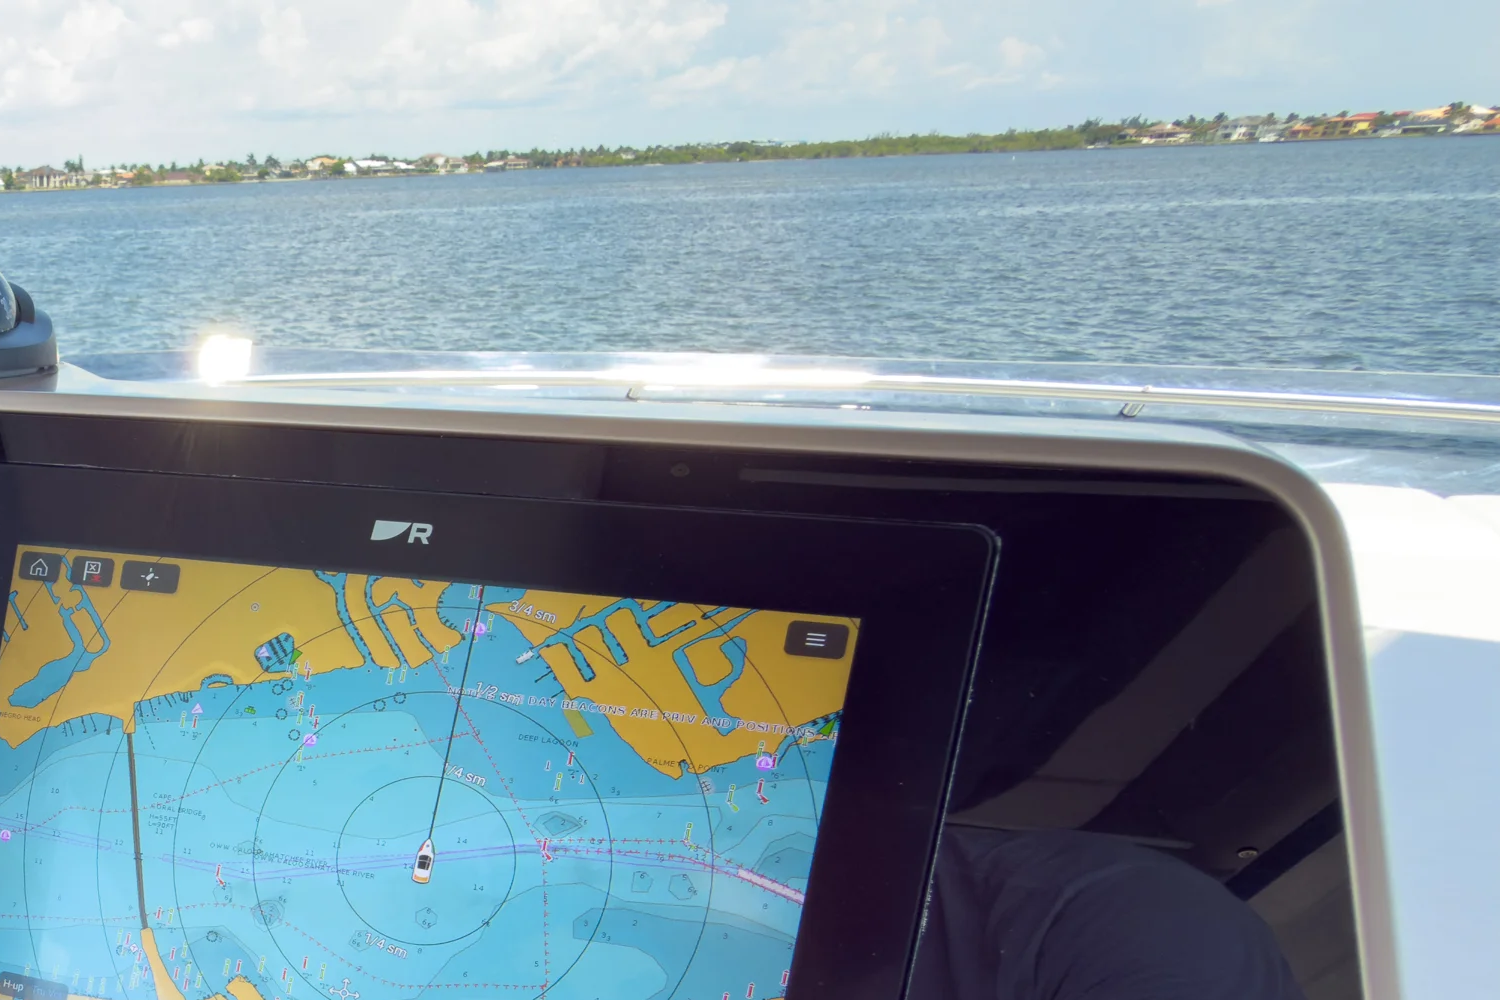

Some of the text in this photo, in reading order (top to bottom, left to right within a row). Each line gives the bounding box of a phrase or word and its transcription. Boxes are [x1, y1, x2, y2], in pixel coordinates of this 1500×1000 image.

[509, 600, 556, 624] 3/4 sm
[631, 706, 658, 720] ARE
[663, 712, 697, 724] PRIV
[701, 717, 731, 729] AND
[518, 733, 538, 742] DEEP
[465, 773, 486, 787] sm
[365, 933, 407, 959] 1/4 sm
[3, 978, 24, 992] H-up
